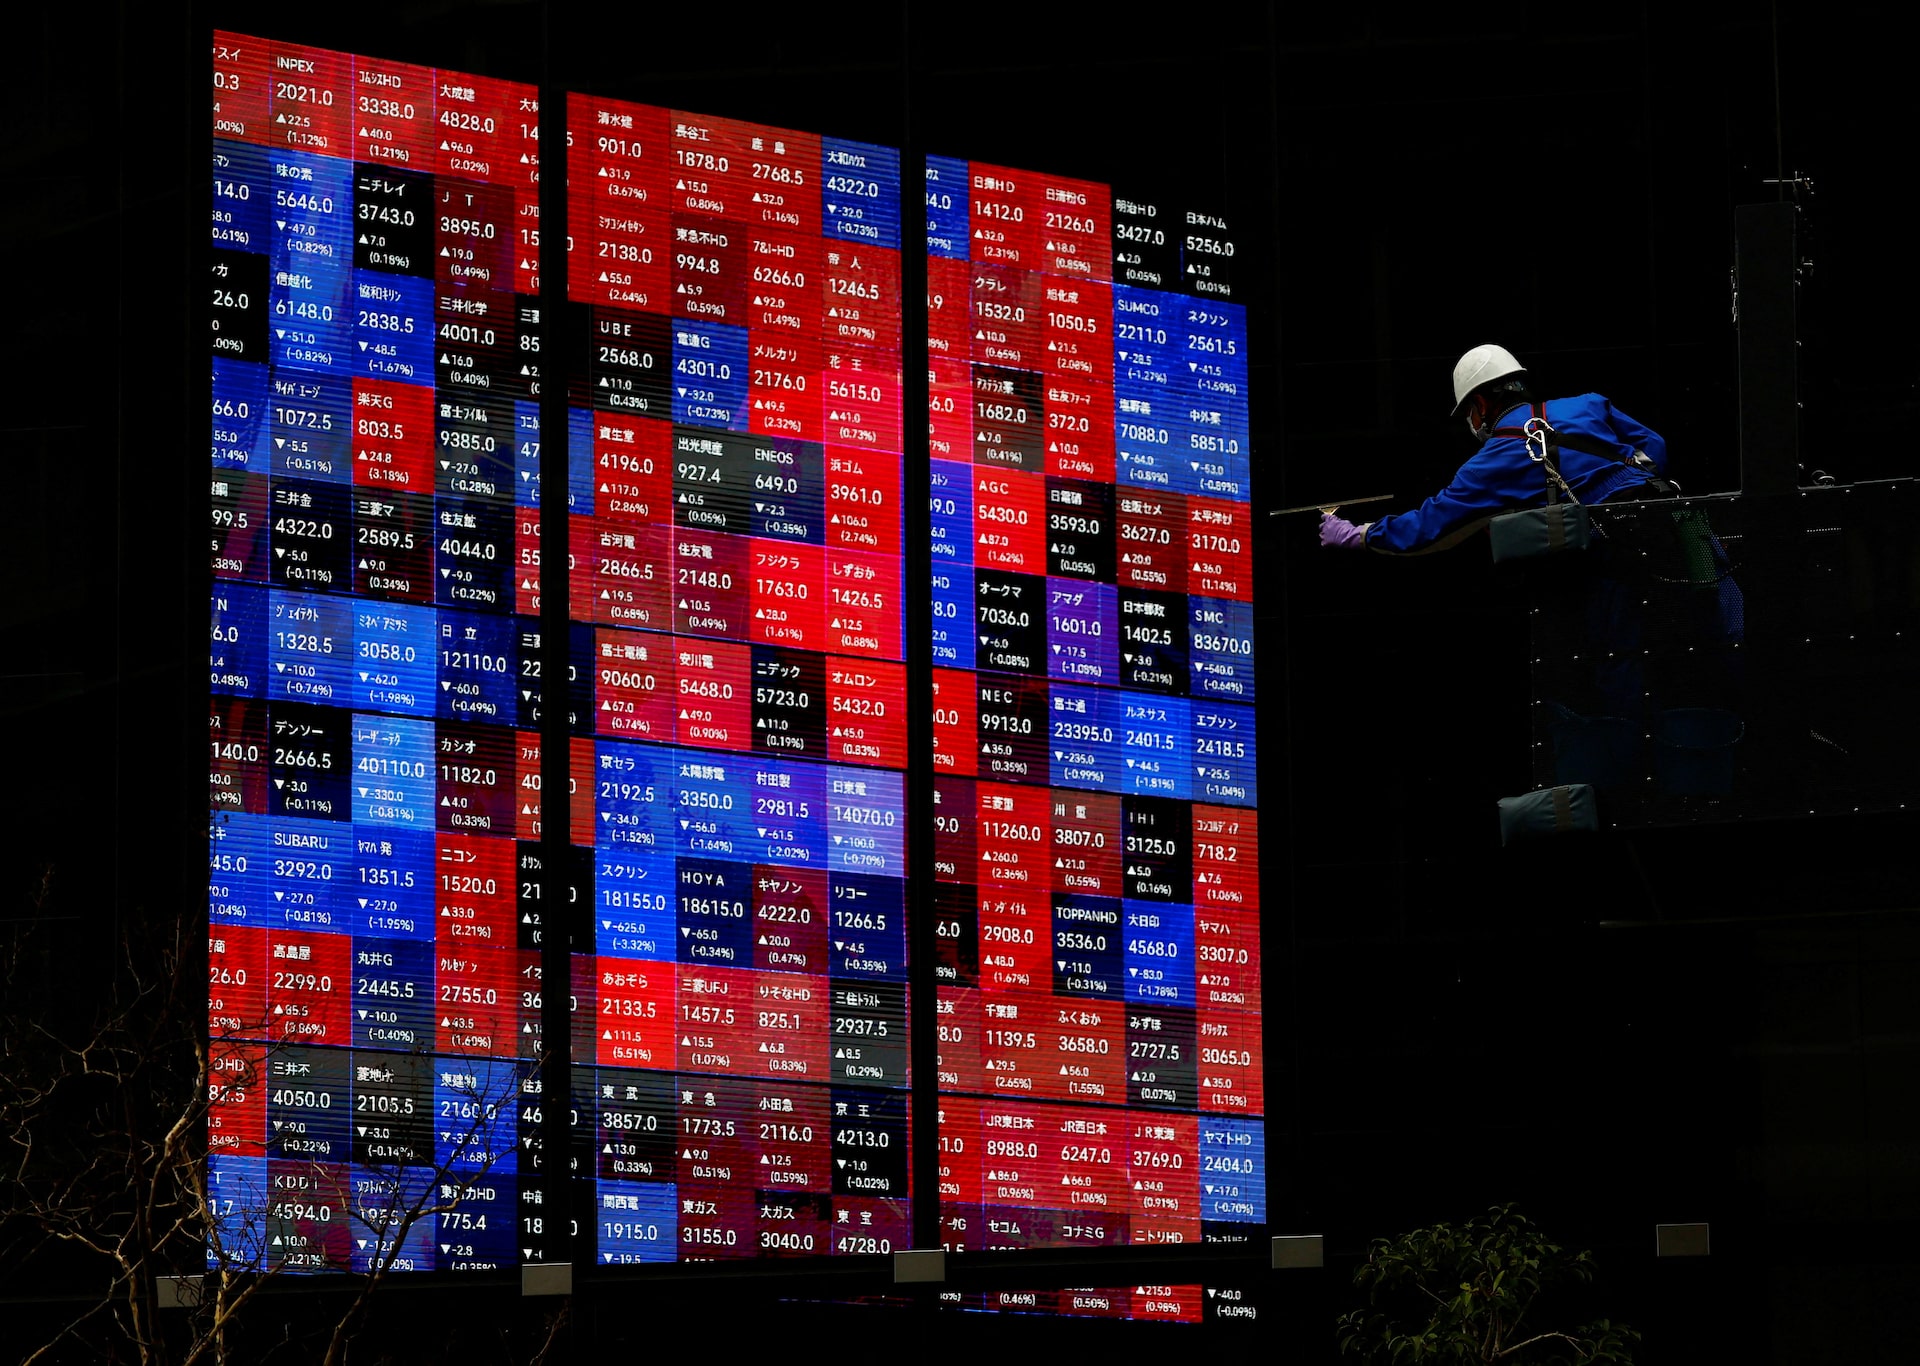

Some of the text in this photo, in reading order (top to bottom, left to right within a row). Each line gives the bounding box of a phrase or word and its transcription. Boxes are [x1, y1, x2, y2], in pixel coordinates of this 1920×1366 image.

[276, 56, 315, 74] INPEX
[276, 82, 333, 106] 2021.0
[439, 83, 475, 103] 大成建
[439, 110, 495, 134] 4828.0
[367, 128, 393, 141] 40.0
[674, 123, 710, 142] 長谷工
[450, 157, 490, 176] (2.02%)
[676, 150, 729, 173] 1878.0
[276, 163, 313, 182] 味の素
[358, 177, 406, 197] ニチレイ
[608, 183, 647, 202] (3.67%)
[826, 176, 879, 198] 4322.0
[276, 190, 333, 214] 5646.0
[974, 200, 1024, 222] 1412.0
[838, 206, 863, 219] -32.0
[1186, 211, 1227, 230] 日本ハム
[440, 216, 495, 239] 3895.0
[451, 247, 474, 261] 19.0
[598, 241, 652, 264] 2138.0
[1186, 235, 1235, 257] 5256.0
[369, 251, 410, 269] (0.18%)
[676, 253, 720, 275] 994.8
[275, 271, 313, 290] 信越化
[609, 272, 632, 286] 55.0
[974, 276, 1007, 292] クラレ
[275, 298, 333, 322] 6148.0
[439, 296, 488, 316] 三井化学
[686, 299, 726, 317] (0.59%)
[975, 301, 1025, 323] 1532.0
[1117, 298, 1160, 316] SUMCO
[358, 310, 414, 334] 2838.5
[1188, 310, 1229, 327] ネクソン
[287, 331, 315, 345] -51.0
[286, 347, 333, 366] (-0.82%)
[599, 346, 653, 369] 2568.0
[754, 344, 797, 362] メルカリ
[450, 370, 490, 388] (0.40%)
[610, 377, 633, 391] 11.0
[754, 369, 806, 392] 2176.0
[357, 392, 393, 409] 楽天G
[275, 407, 332, 431] 1072.5
[977, 402, 1027, 424] 1682.0
[440, 430, 495, 452] 9385.0
[369, 450, 392, 464] 24.8
[599, 452, 654, 475] 4196.0
[754, 447, 794, 465] ENEOS
[677, 462, 722, 484] 927.4
[830, 458, 863, 475] 浜ゴム
[611, 483, 639, 497] 117.0
[609, 499, 649, 517] (2.86%)
[1050, 514, 1100, 535] 3593.0
[358, 527, 414, 550] 2589.5
[1192, 533, 1241, 554] 3170.0
[286, 549, 308, 562] -5.0
[756, 553, 800, 570] フジクラ
[600, 558, 654, 580] 2866.5
[1060, 558, 1096, 575] (0.05%)
[369, 575, 410, 593] (0.34%)
[979, 581, 1022, 598] オークマ
[451, 586, 496, 604] (-0.22%)
[611, 589, 634, 603] 19.5
[1052, 591, 1084, 606] アマダ
[979, 606, 1029, 627] 7036.0
[276, 631, 333, 654] 1328.5
[1123, 625, 1172, 646] 1402.5
[1193, 633, 1251, 655] 83670.0
[442, 650, 507, 673] 12110.0
[756, 662, 801, 679] ニデック
[601, 669, 656, 691] 9060.0
[831, 671, 877, 687] オムロン
[452, 683, 480, 696] -60.0
[756, 687, 809, 708] 5723.0
[451, 698, 497, 716] (-0.49%)
[1125, 705, 1167, 721] ルネサス
[274, 720, 324, 737] デンソー
[981, 713, 1032, 734] 9913.0
[1196, 714, 1237, 730] エプソン
[1053, 722, 1113, 743] 23395.0
[274, 748, 332, 769] 2666.5
[599, 754, 635, 771] 京セラ
[991, 759, 1028, 775] (0.35%)
[286, 780, 308, 793] -3.0
[601, 781, 655, 803] 2192.5
[285, 796, 332, 814] (-0.11%)
[757, 797, 809, 819] 2981.5
[690, 821, 717, 834] -56.0
[982, 821, 1041, 842] 11260.0
[274, 832, 328, 850] SUBARU
[1126, 836, 1176, 856] 3125.0
[441, 848, 477, 863] ニコン
[1197, 843, 1237, 862] 718.2
[273, 859, 332, 880] 3292.0
[441, 874, 496, 895] 1520.0
[758, 877, 803, 894] キヤノン
[835, 885, 868, 900] リコー
[1136, 881, 1172, 897] (0.16%)
[285, 892, 314, 905] -27.0
[681, 897, 744, 918] 18615.0
[757, 904, 811, 924] 4222.0
[451, 923, 491, 939] (2.21%)
[1198, 919, 1231, 935] ヤマハ
[1056, 931, 1107, 951] 3536.0
[273, 943, 311, 961] 高島屋
[357, 950, 393, 967] 丸井G
[691, 944, 735, 961] (-0.34%)
[1199, 945, 1249, 965] 3307.0
[602, 971, 648, 989] あおぞら
[441, 984, 497, 1005] 2755.0
[366, 1010, 398, 1023] -10.0
[602, 997, 657, 1019] 2133.5
[758, 1011, 800, 1030] 825.1
[1058, 1010, 1102, 1026] ふくおか
[1129, 1016, 1162, 1031] みずほ
[368, 1027, 415, 1044] (-0.40%)
[1058, 1035, 1109, 1054] 3658.0
[768, 1042, 785, 1054] 6.8
[1130, 1041, 1180, 1061] 2727.5
[272, 1061, 311, 1077] 三井不
[845, 1064, 884, 1080] (0.29%)
[357, 1094, 414, 1115] 2105.5
[758, 1096, 794, 1113] 小田急
[602, 1111, 657, 1131] 3857.0
[759, 1123, 813, 1143] 2116.0
[836, 1129, 889, 1148] 4213.0
[283, 1139, 331, 1155] (-0.22%)
[987, 1140, 1038, 1159] 8988.0
[1061, 1145, 1111, 1164] 6247.0
[613, 1159, 653, 1176] (0.33%)
[847, 1160, 868, 1172] -1.0
[1133, 1150, 1183, 1169] 3769.0
[682, 1199, 718, 1215] 東ガス
[760, 1204, 795, 1220] 大ガス
[440, 1212, 487, 1231] 775.4
[988, 1219, 1021, 1235] セコム
[604, 1222, 658, 1241] 1915.0
[682, 1226, 737, 1246] 3155.0
[1134, 1229, 1184, 1244] ニトリHD
[760, 1231, 814, 1251] 3040.0
[451, 1244, 474, 1257] -2.8
[999, 1292, 1036, 1307] (0.46%)
[1217, 1289, 1242, 1301] -40.0
[1145, 1300, 1181, 1316] (0.98%)
[1216, 1304, 1257, 1320] (-0.09%)
